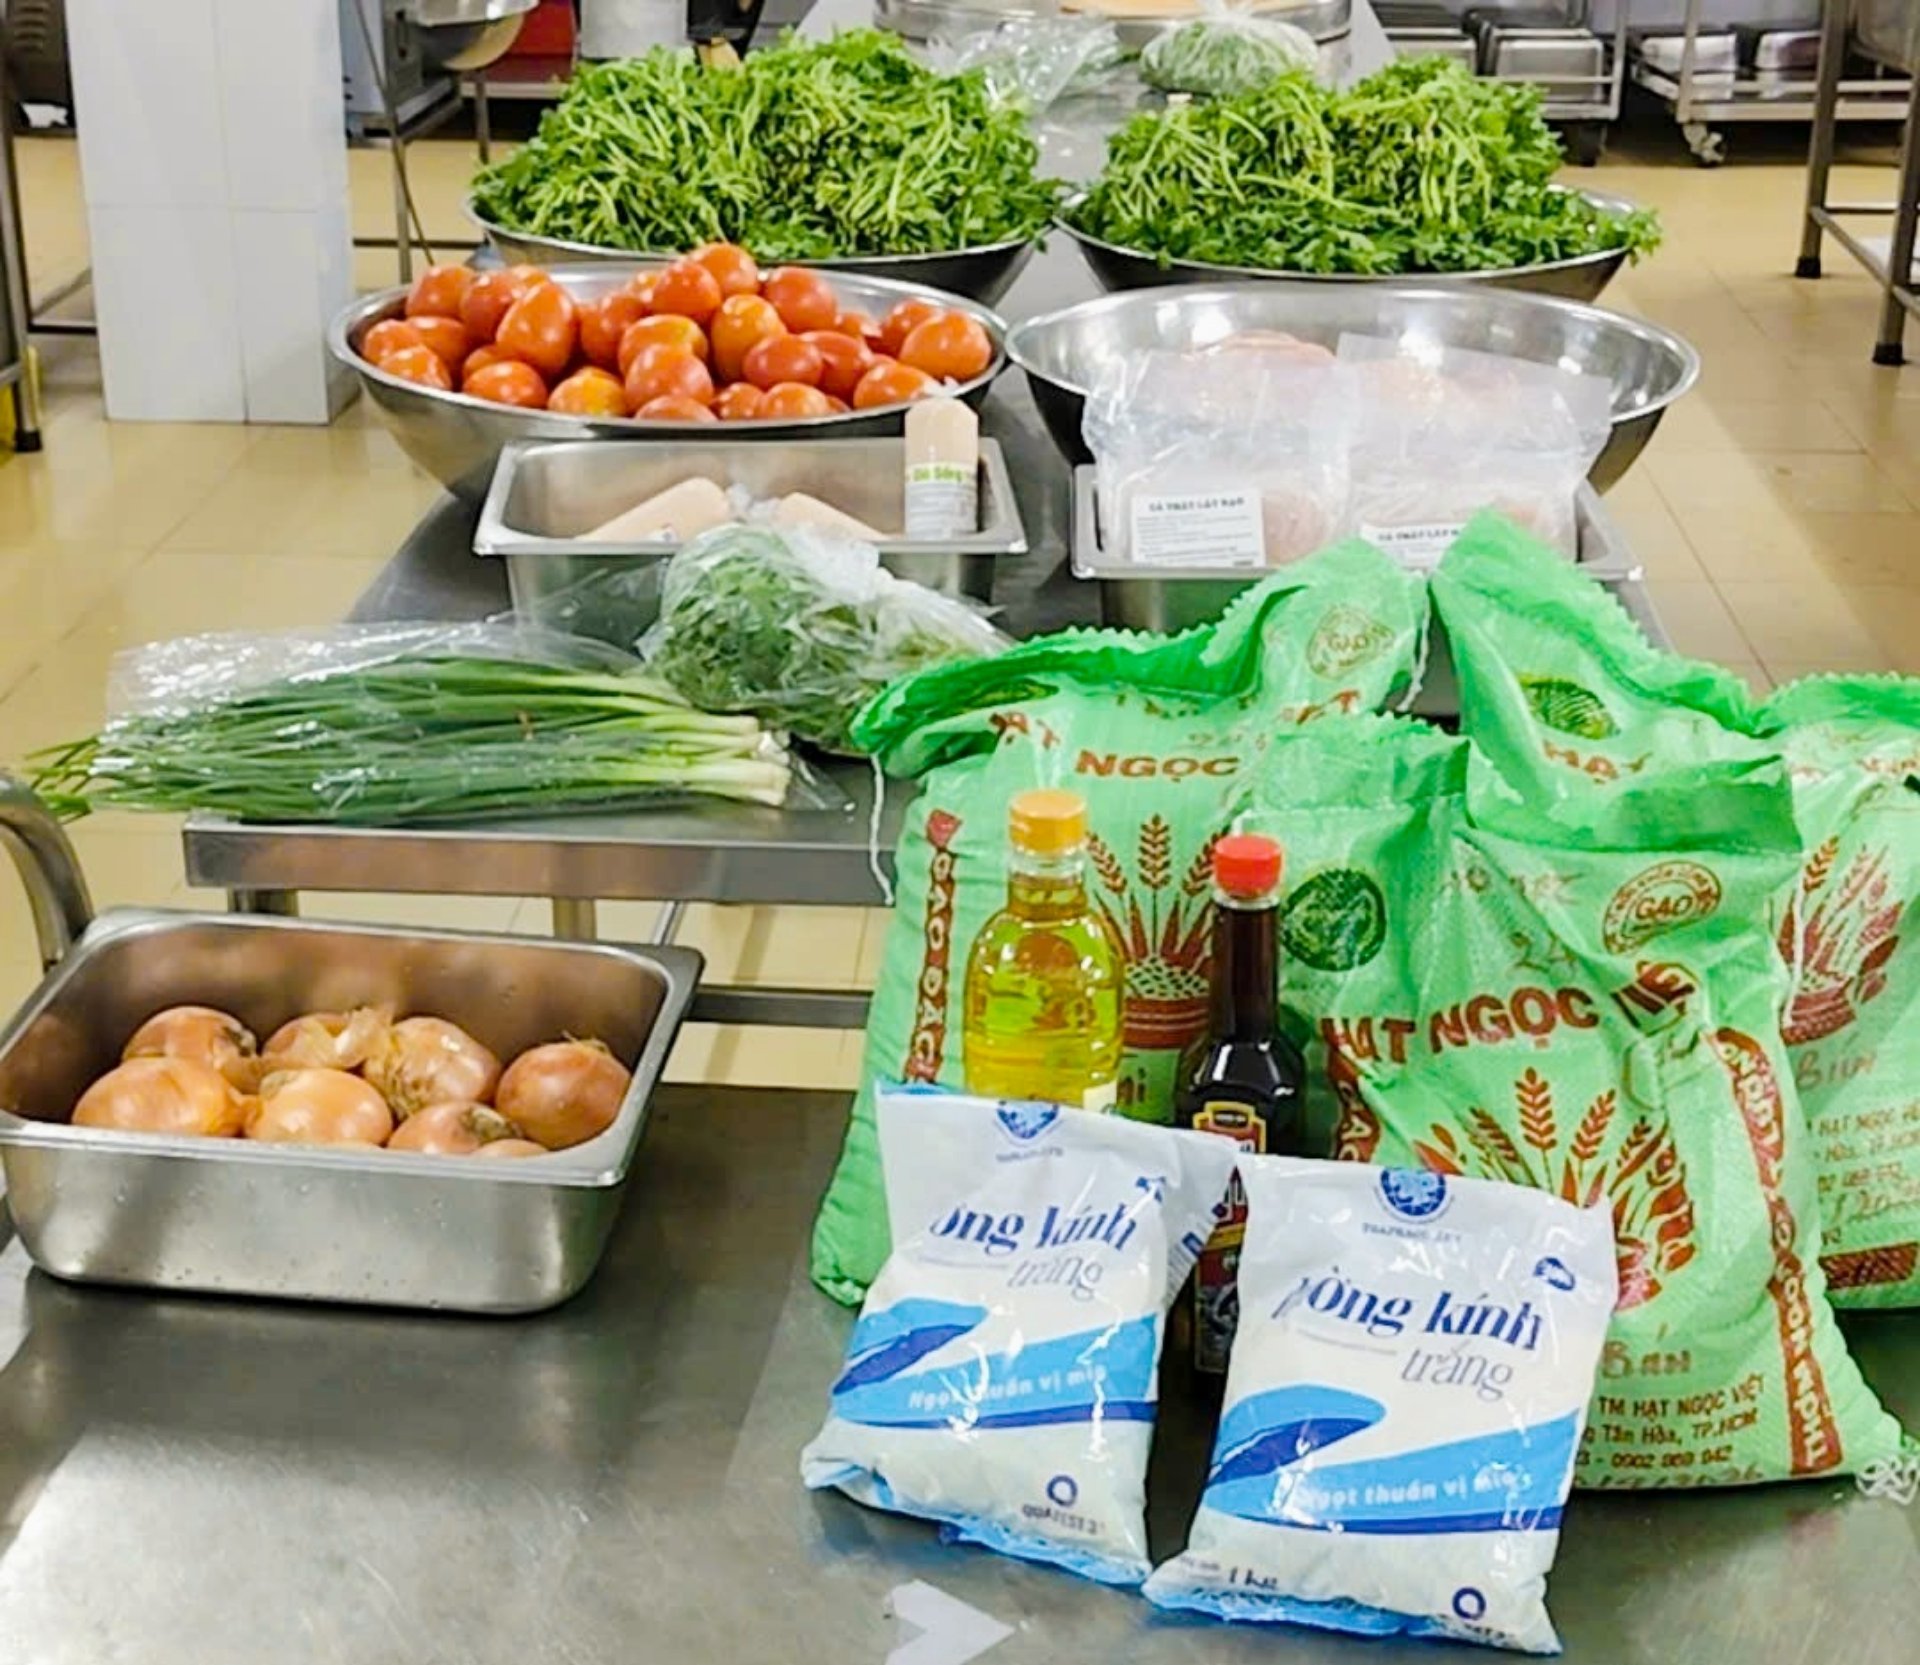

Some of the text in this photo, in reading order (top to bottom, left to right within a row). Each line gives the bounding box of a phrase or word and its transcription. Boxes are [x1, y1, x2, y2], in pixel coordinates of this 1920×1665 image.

[1074, 748, 1240, 783] NGỌC
[1429, 986, 1601, 1050] NGỌC
[1423, 1290, 1544, 1351] kính
[1598, 1396, 1626, 1416] TM
[1633, 1399, 1669, 1423] HẠT
[1677, 1390, 1726, 1416] NGỌC
